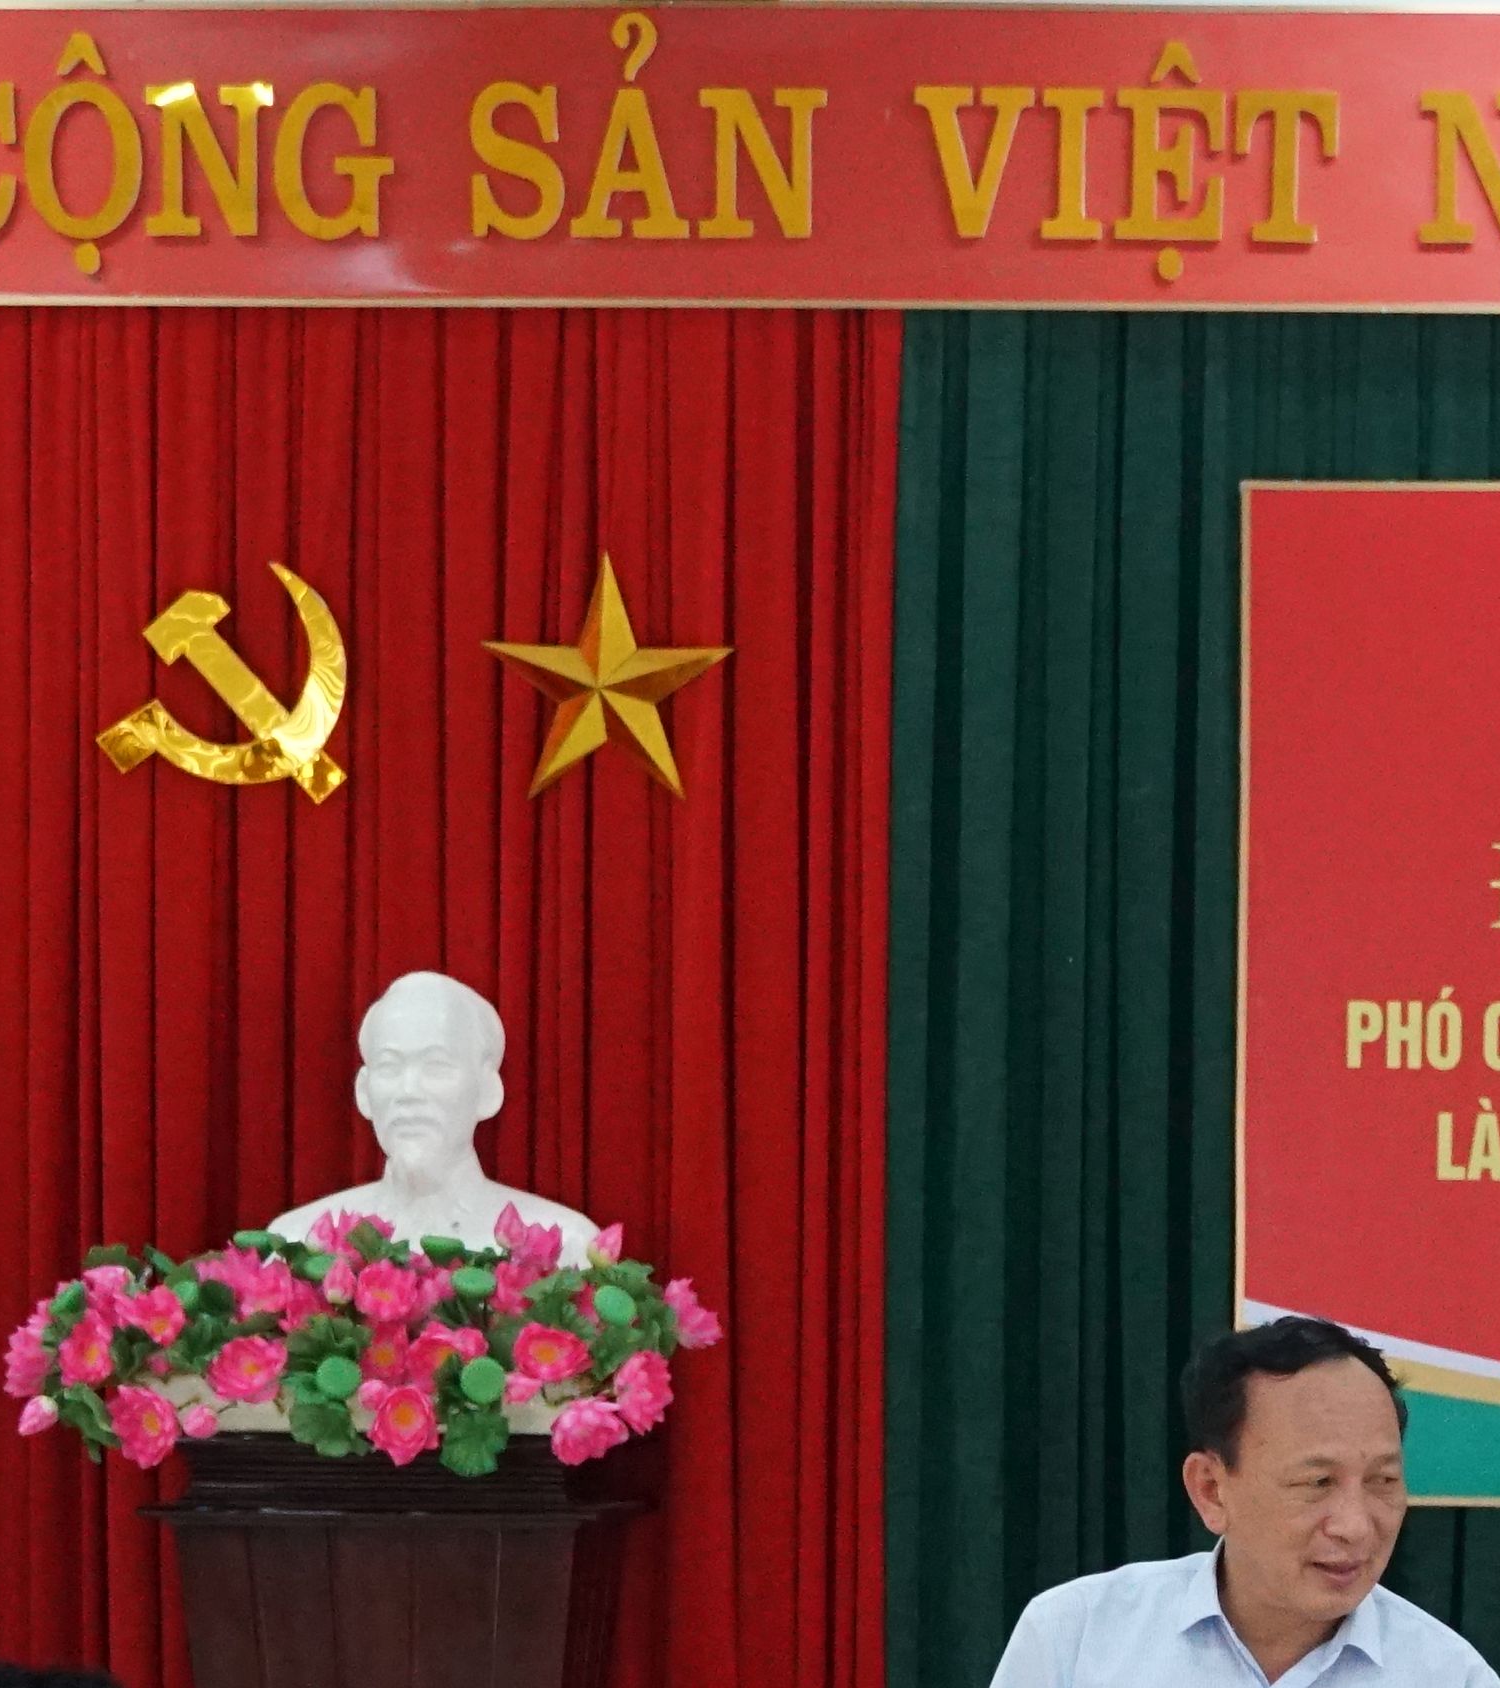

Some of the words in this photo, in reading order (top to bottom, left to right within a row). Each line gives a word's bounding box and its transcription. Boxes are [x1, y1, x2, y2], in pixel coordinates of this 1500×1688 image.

[469, 13, 828, 241] SẢN
[914, 41, 1340, 282] VIỆT
[1346, 986, 1462, 1071] PHÓ
